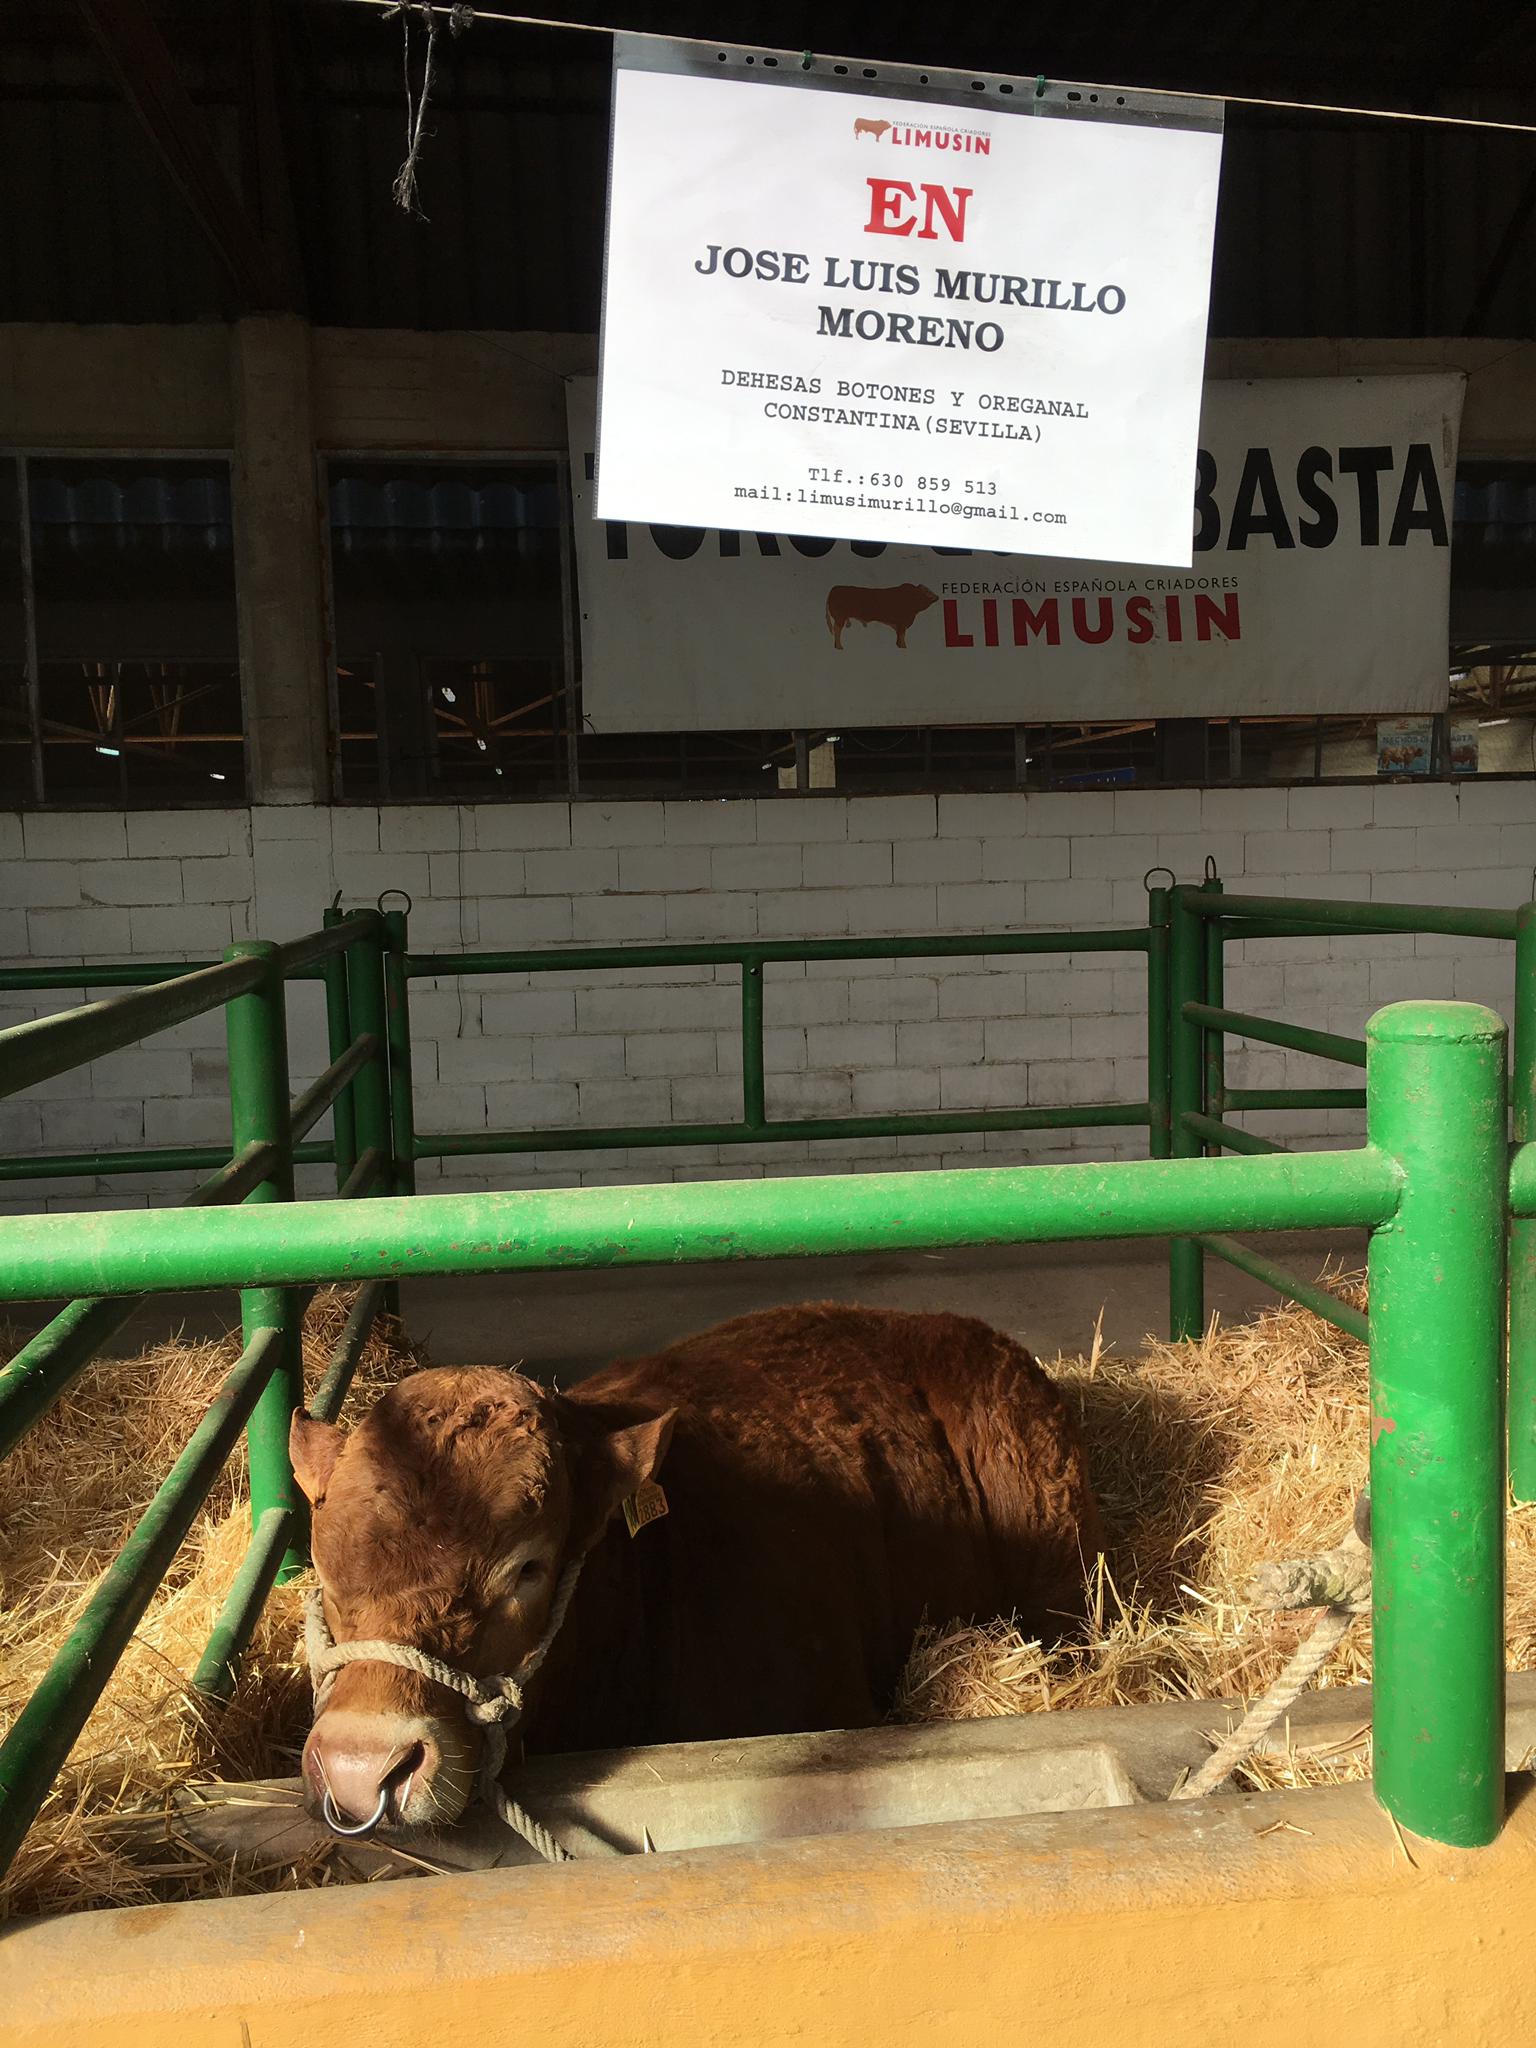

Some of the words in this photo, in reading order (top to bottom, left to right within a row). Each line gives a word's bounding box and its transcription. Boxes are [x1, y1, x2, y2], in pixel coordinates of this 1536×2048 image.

[892, 127, 990, 155] LIMUSIN
[864, 178, 974, 242] EN
[695, 245, 810, 283] JOSE
[823, 256, 920, 295] LUIS
[933, 268, 1127, 315] MURILLO
[816, 306, 1005, 353] MORENO
[720, 369, 822, 394] DEHESAS
[836, 381, 935, 405] BOTONES
[950, 391, 965, 407] Y
[978, 395, 1090, 419] OREGANAL
[764, 402, 1043, 444] CONSTANTINA(SEVILLA)
[808, 467, 904, 488] Tlf.:630
[917, 477, 951, 492] 859
[964, 481, 997, 496] 513
[733, 485, 1068, 525] mail:limusimurillo@gmail.com
[941, 580, 1047, 595] FEDERACIÓN
[1053, 577, 1138, 593] ESPAÑOLA
[1144, 576, 1239, 591] CRIADORES
[943, 592, 1241, 648] LIMUSIN
